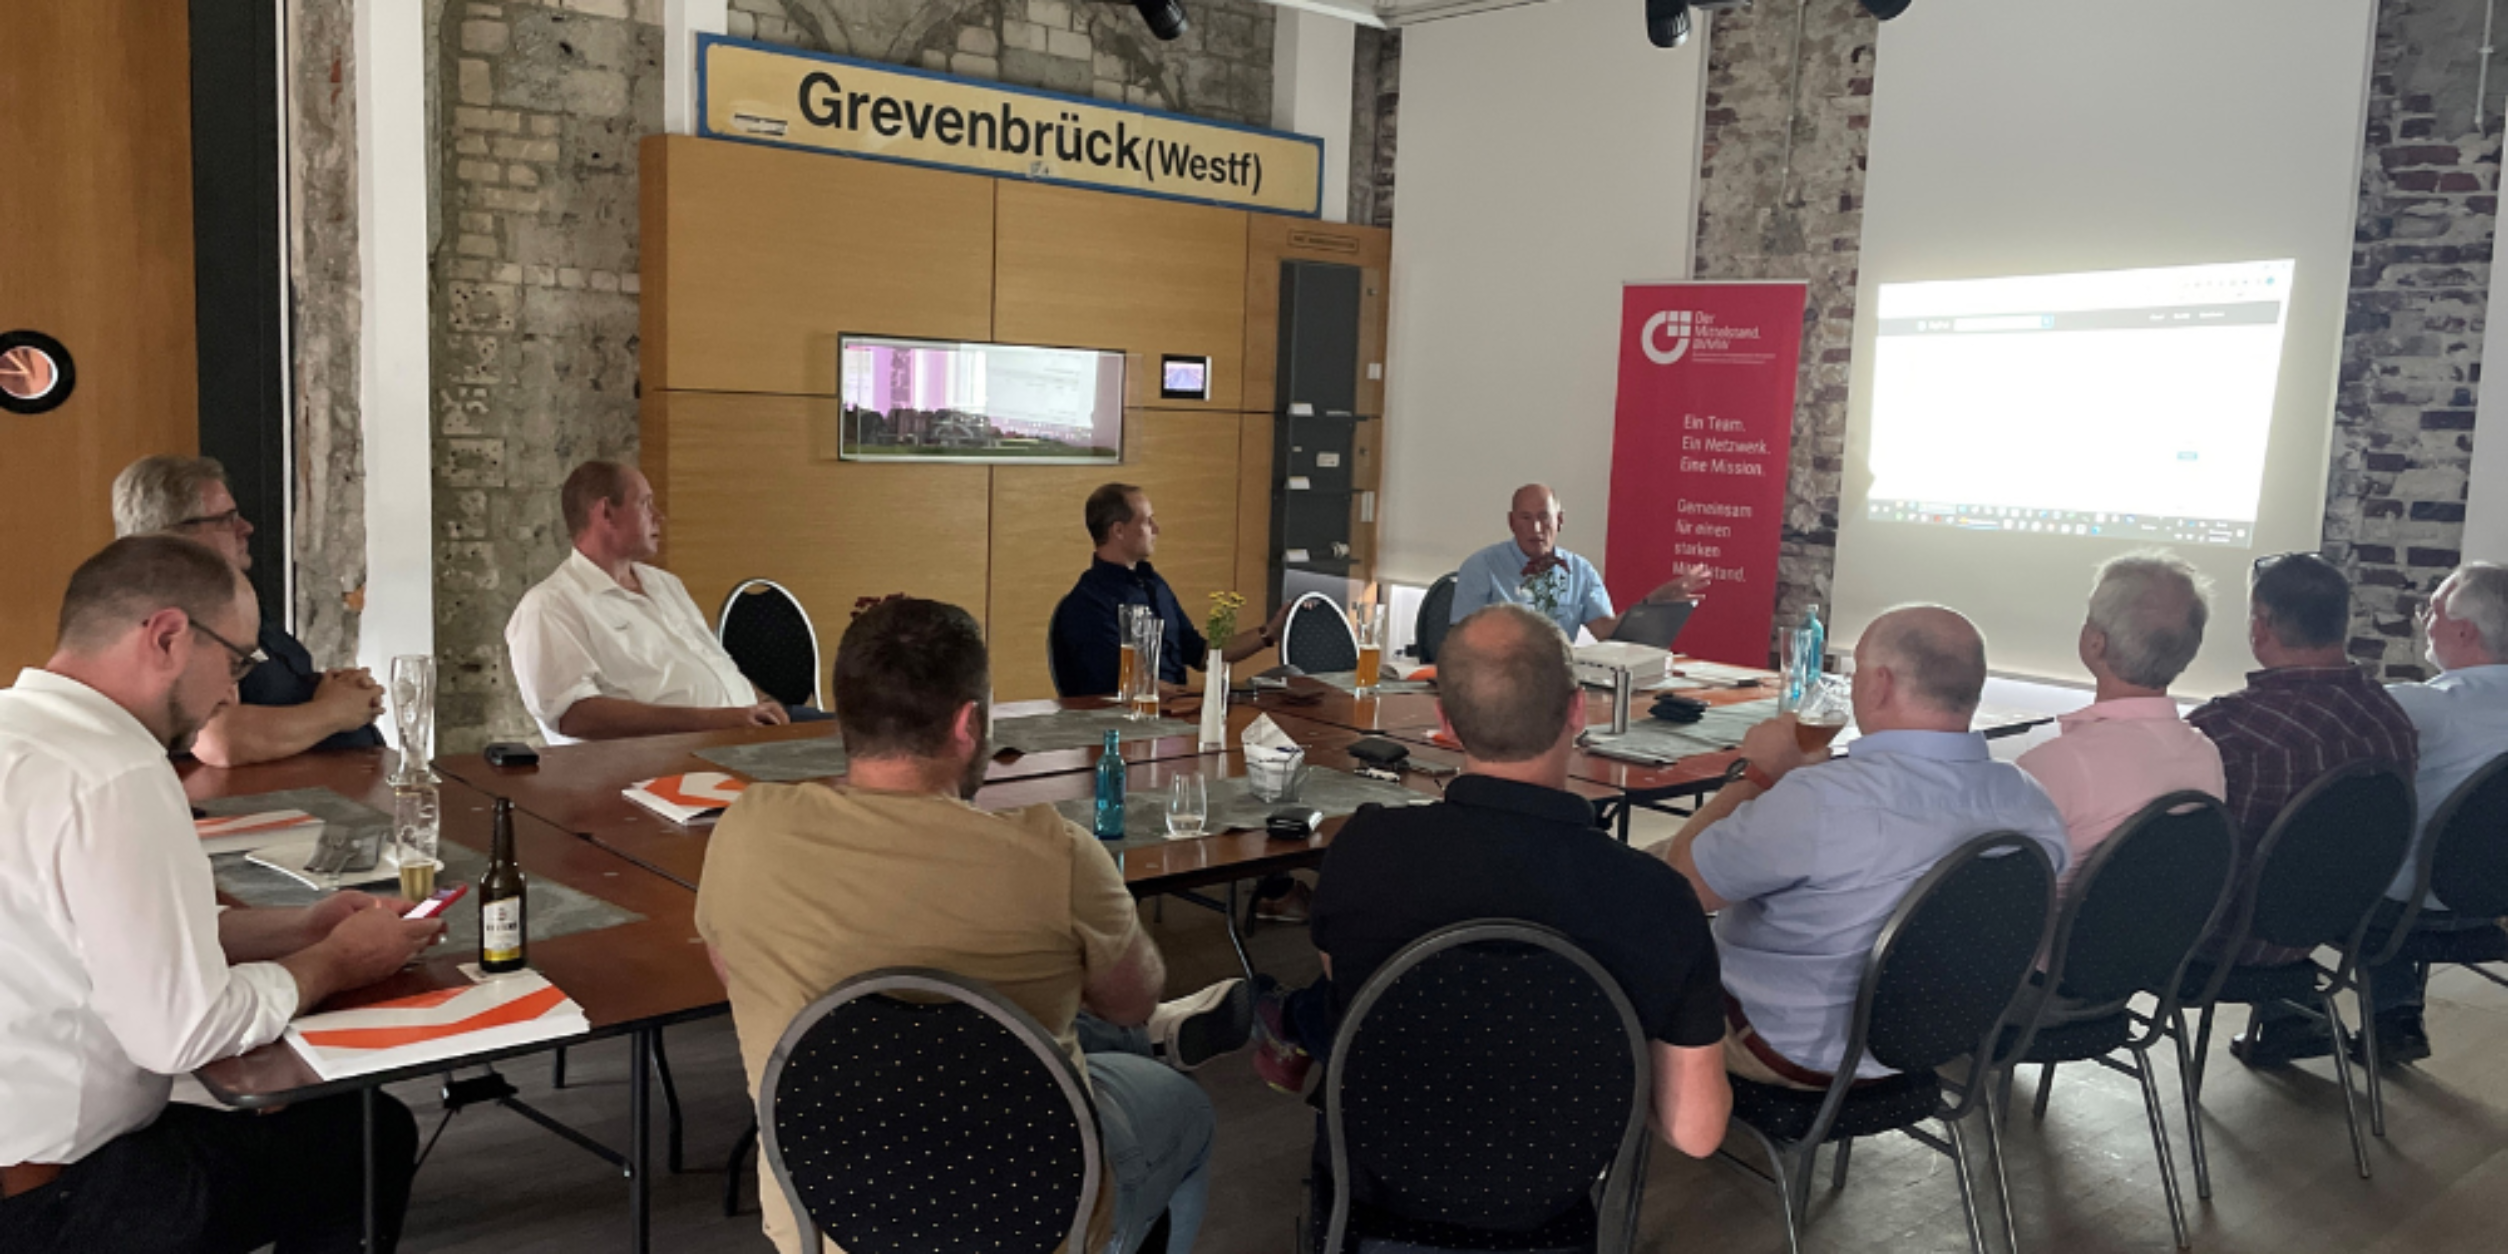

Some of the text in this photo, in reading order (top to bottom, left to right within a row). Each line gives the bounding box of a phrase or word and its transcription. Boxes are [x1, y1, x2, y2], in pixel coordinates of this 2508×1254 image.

[798, 71, 1263, 196] Grevenbrück (Westf)
[1684, 413, 1746, 432] Ein Team.
[1682, 436, 1771, 455] Ein Netzwerk.
[1680, 456, 1766, 476] Eine Mission.
[1677, 498, 1752, 518] Gemeinsam
[1675, 518, 1731, 538] für einen
[1674, 541, 1721, 558] starken
